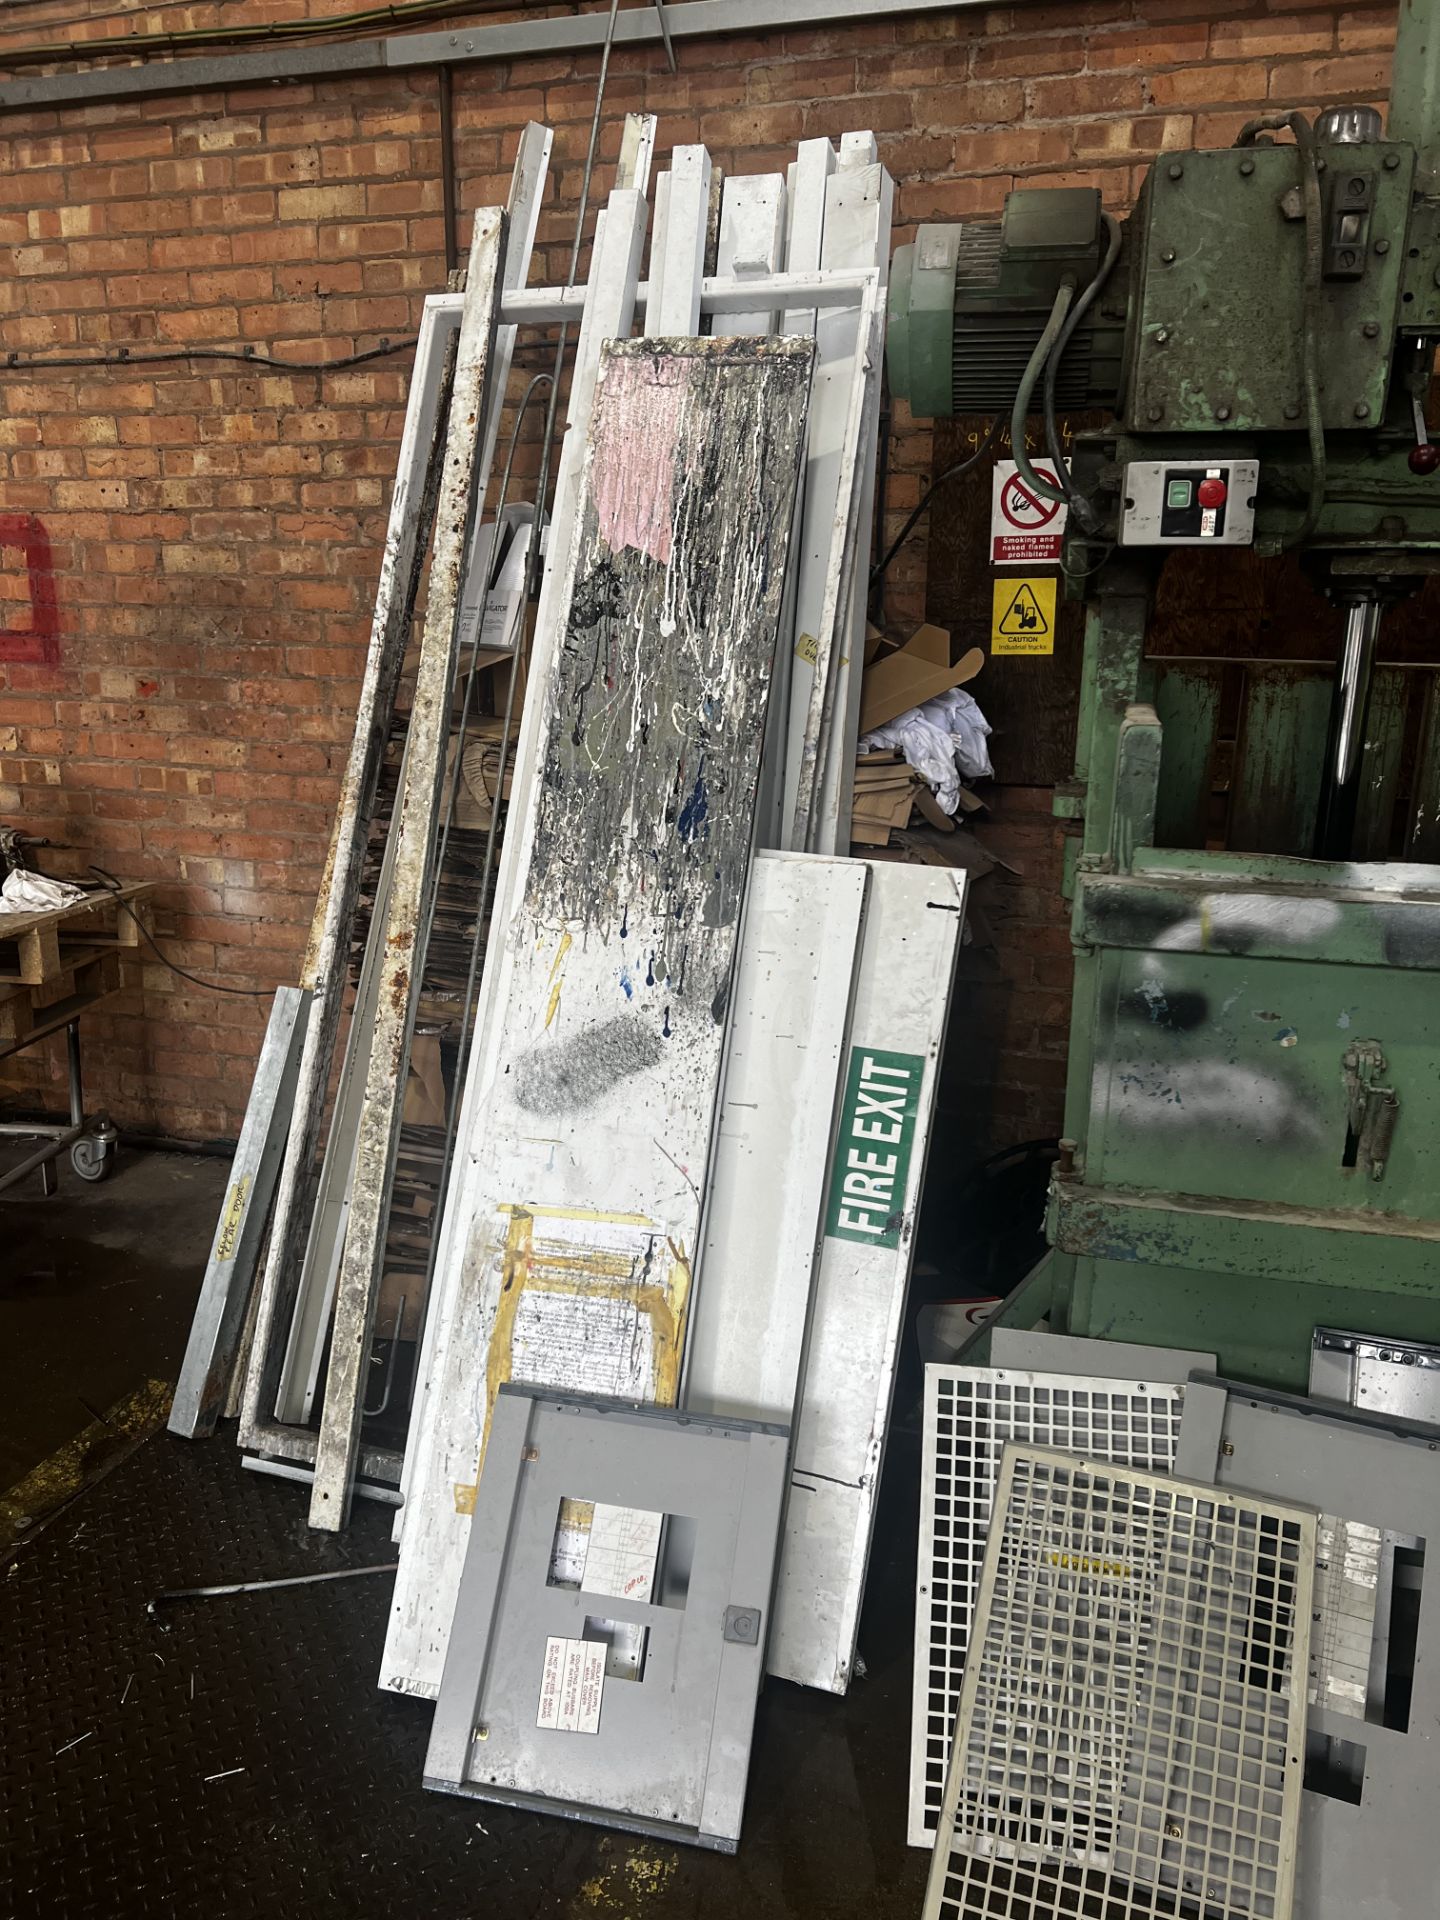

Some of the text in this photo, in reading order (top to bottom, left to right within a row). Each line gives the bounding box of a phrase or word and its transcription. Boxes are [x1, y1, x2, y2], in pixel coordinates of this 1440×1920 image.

[1003, 535, 1054, 545] Smoking and
[1002, 543, 1054, 551] naked flames
[1007, 550, 1048, 559] prohibited
[998, 643, 1027, 651] Industrial
[837, 1056, 911, 1236] FIRE EXIT
[554, 1645, 560, 1653] DO
[546, 1670, 551, 1678] ON
